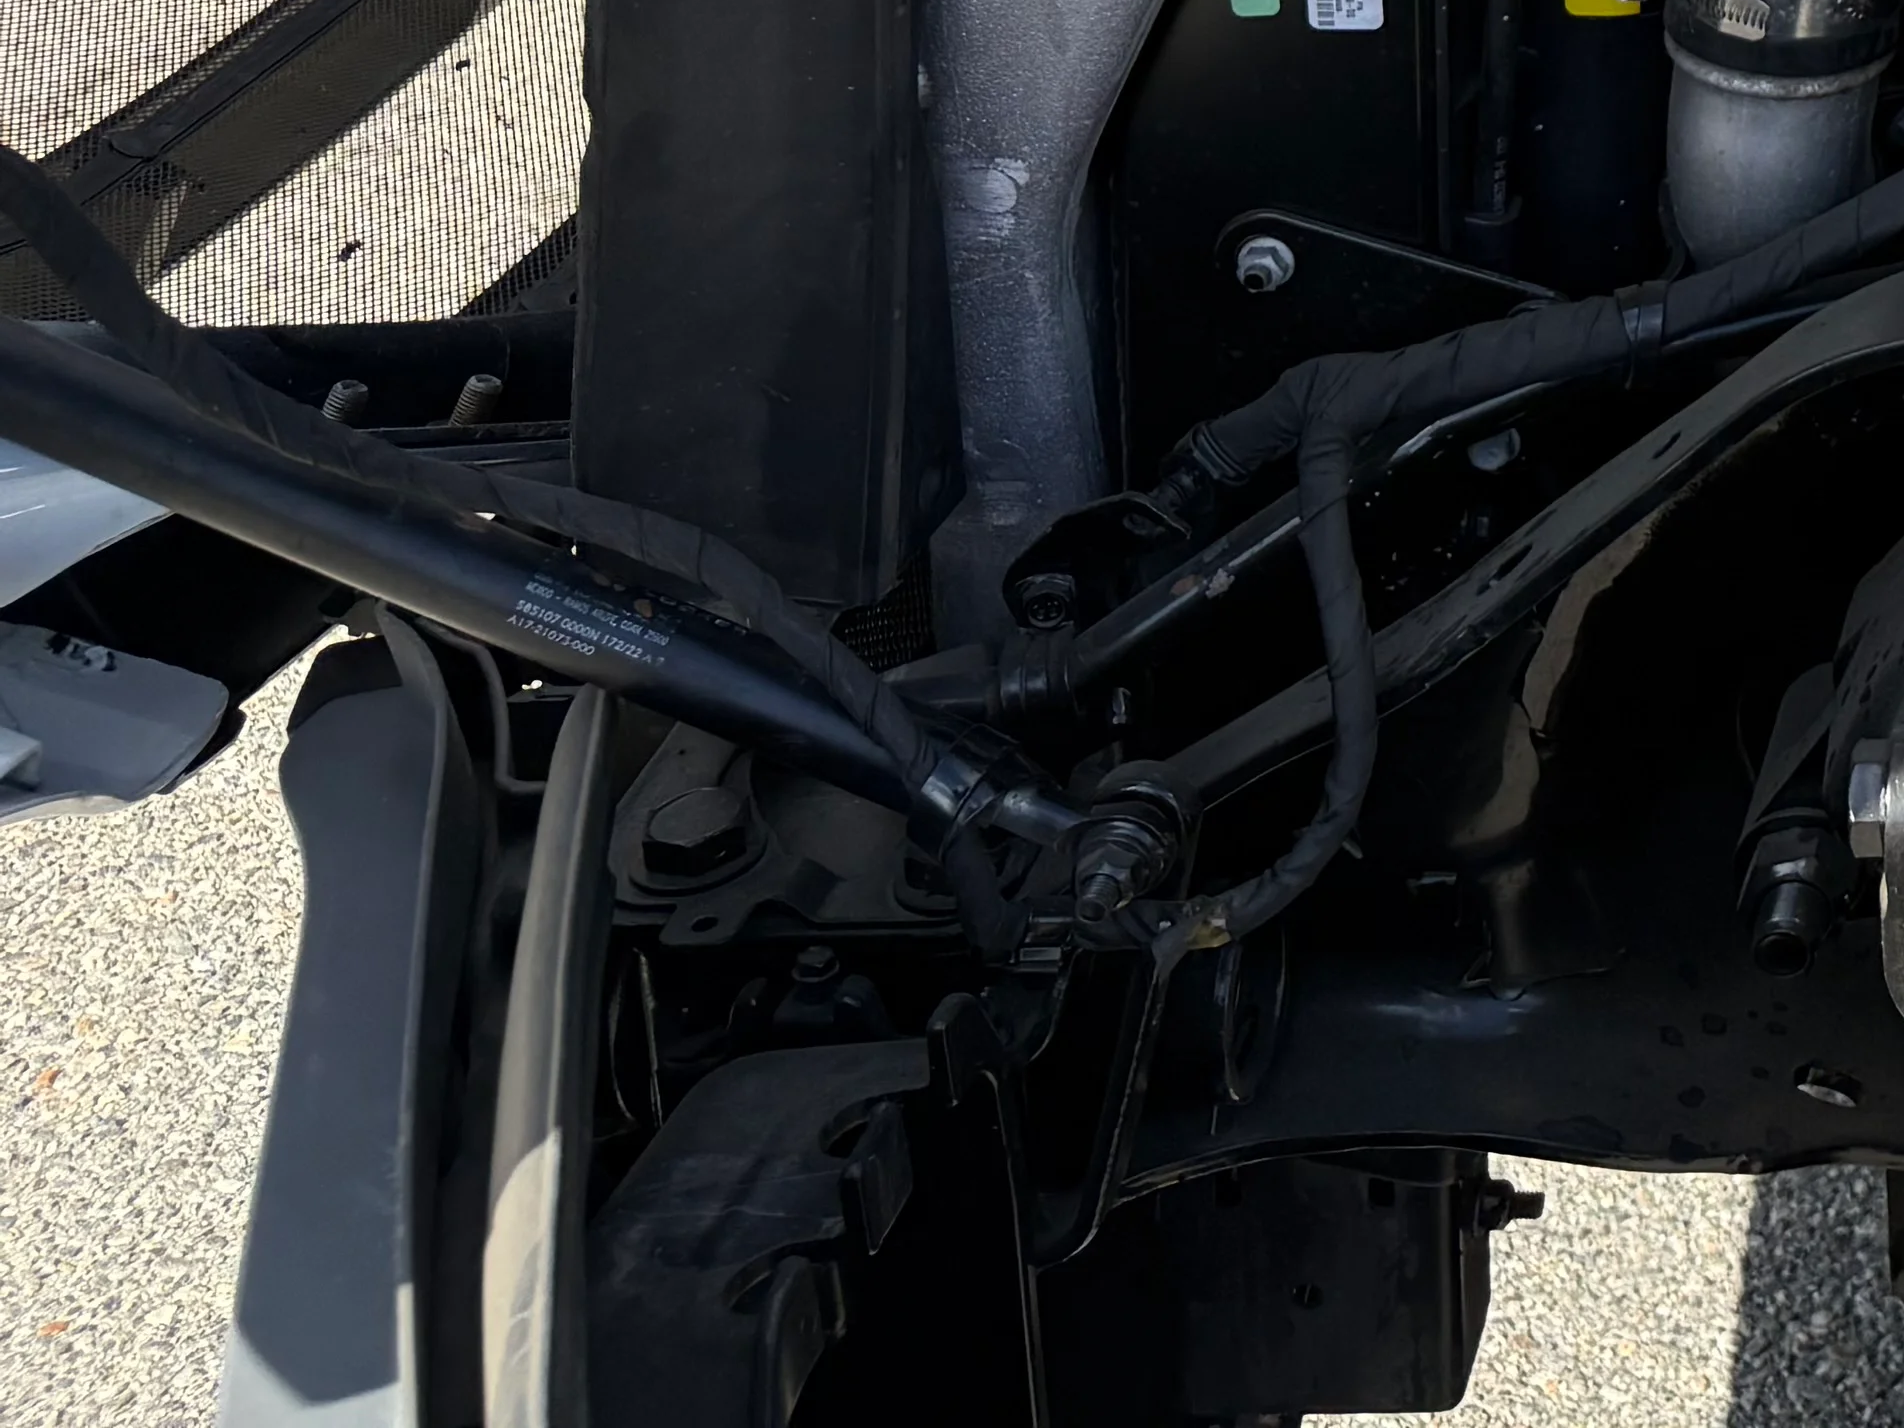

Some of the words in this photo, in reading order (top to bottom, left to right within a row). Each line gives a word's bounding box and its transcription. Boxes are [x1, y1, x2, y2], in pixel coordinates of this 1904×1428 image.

[506, 615, 597, 657] A17-21073-000
[516, 599, 561, 625] 585107
[602, 633, 641, 659] 172/22
